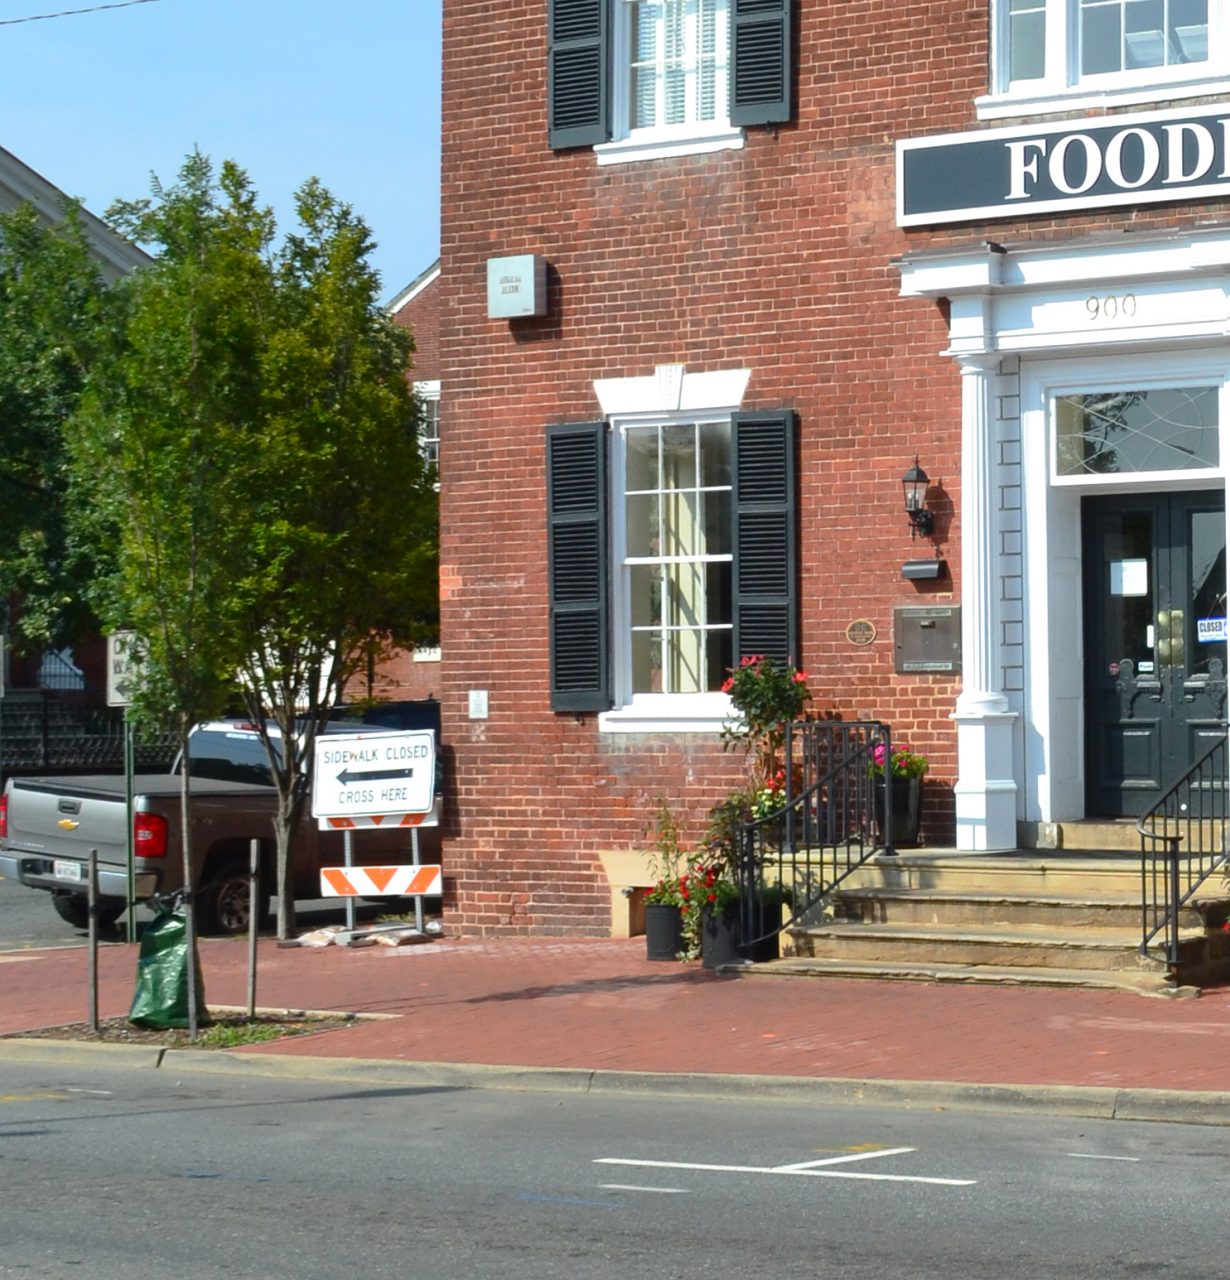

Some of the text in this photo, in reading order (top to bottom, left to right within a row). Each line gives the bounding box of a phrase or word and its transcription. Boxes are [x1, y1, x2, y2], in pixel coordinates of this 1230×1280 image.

[1086, 293, 1136, 320] 900
[1200, 621, 1222, 632] CLOSED
[324, 745, 428, 763] SIDEWALK CLOSED
[339, 787, 408, 804] CROSS HERE
